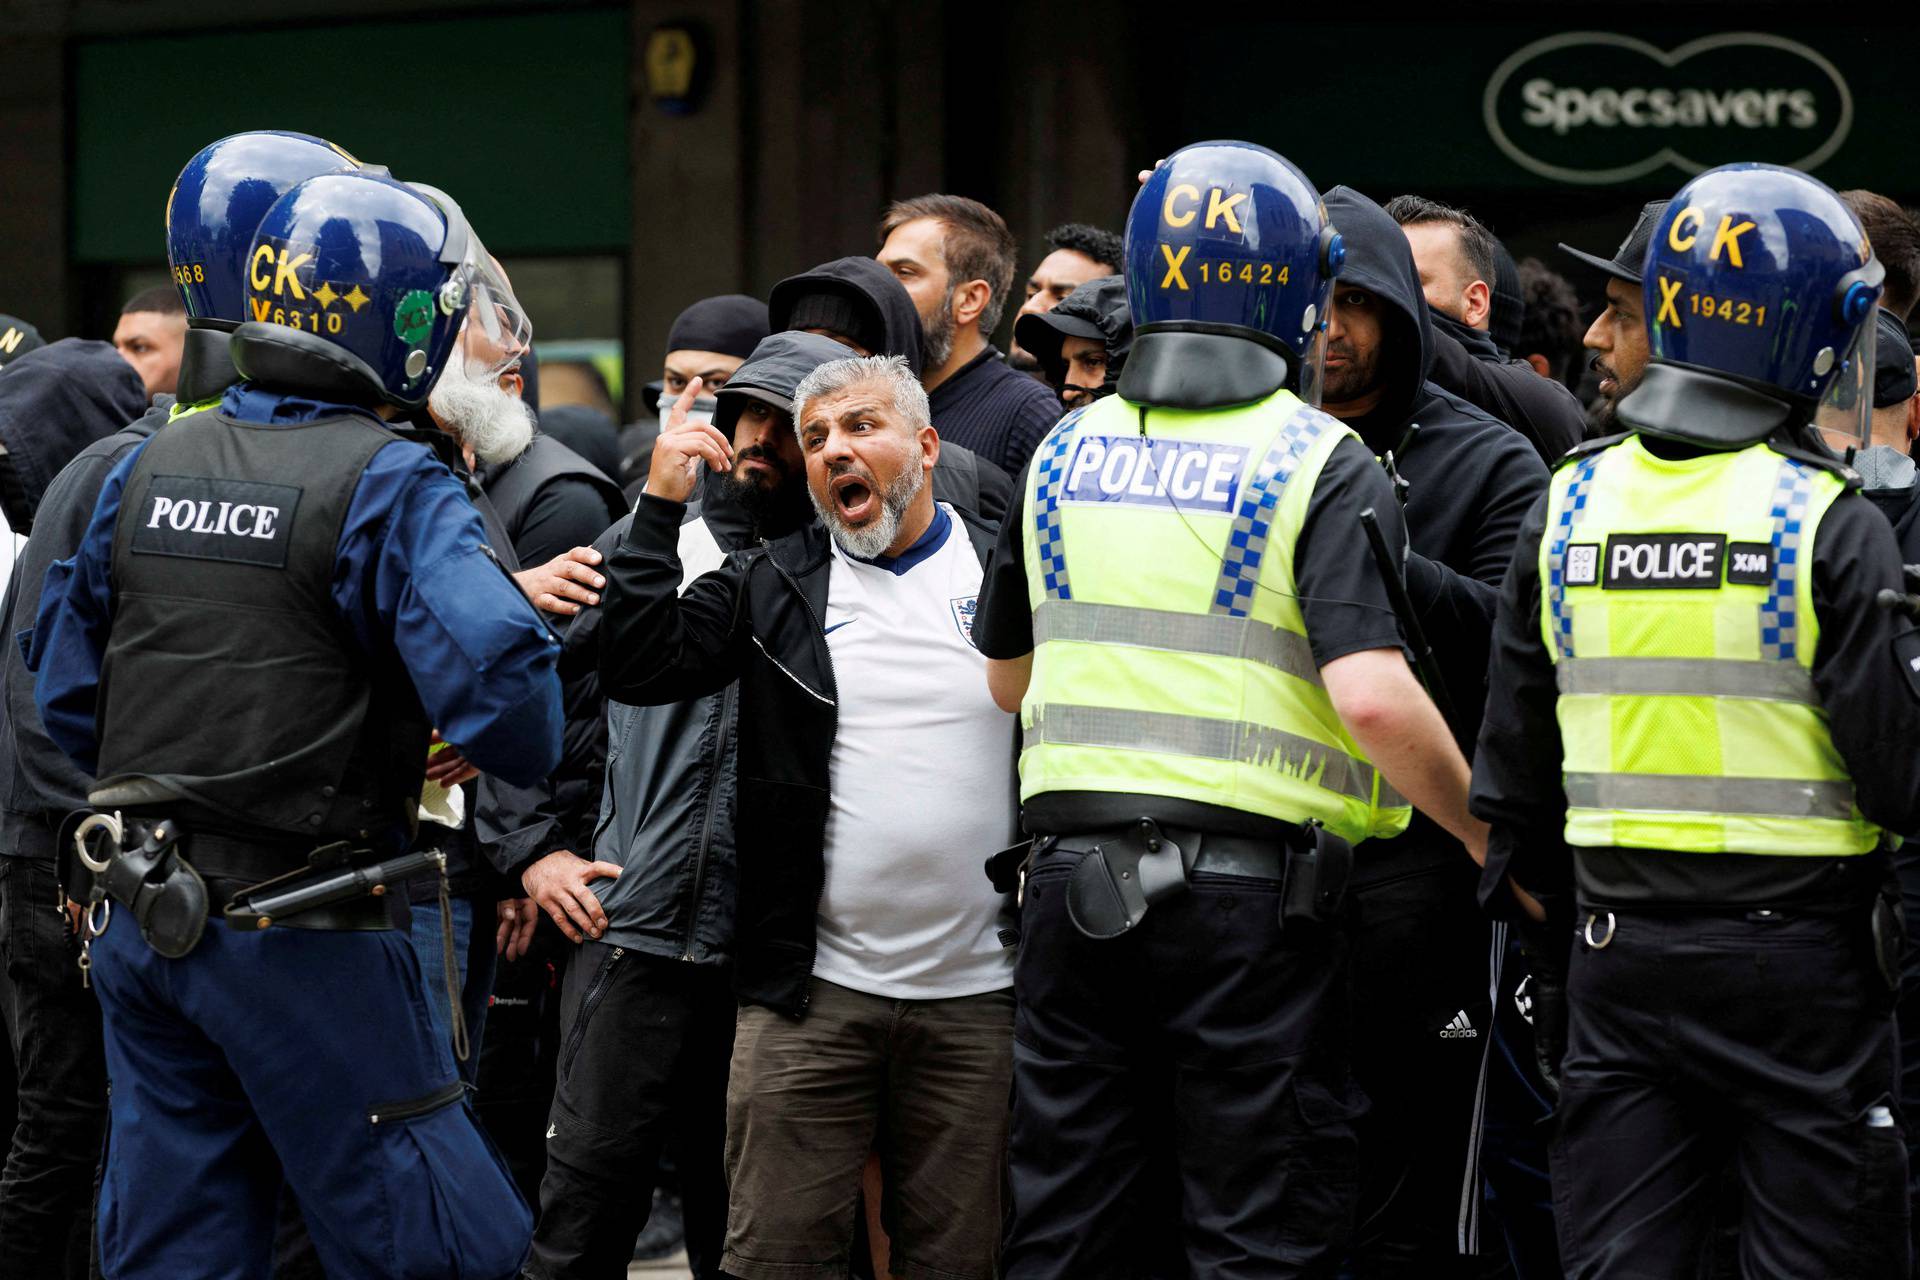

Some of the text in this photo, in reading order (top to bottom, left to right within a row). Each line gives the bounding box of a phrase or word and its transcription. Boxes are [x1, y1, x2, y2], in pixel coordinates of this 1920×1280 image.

[1521, 78, 1818, 135] Specsavers
[1164, 184, 1248, 234] CK
[1668, 206, 1757, 268] CK
[251, 244, 313, 300] CK
[1067, 443, 1239, 503] POLICE
[146, 497, 280, 540] POLICE
[1610, 542, 1717, 580] POLICE
[1732, 553, 1768, 572] XM
[1440, 1027, 1477, 1038] adidas
